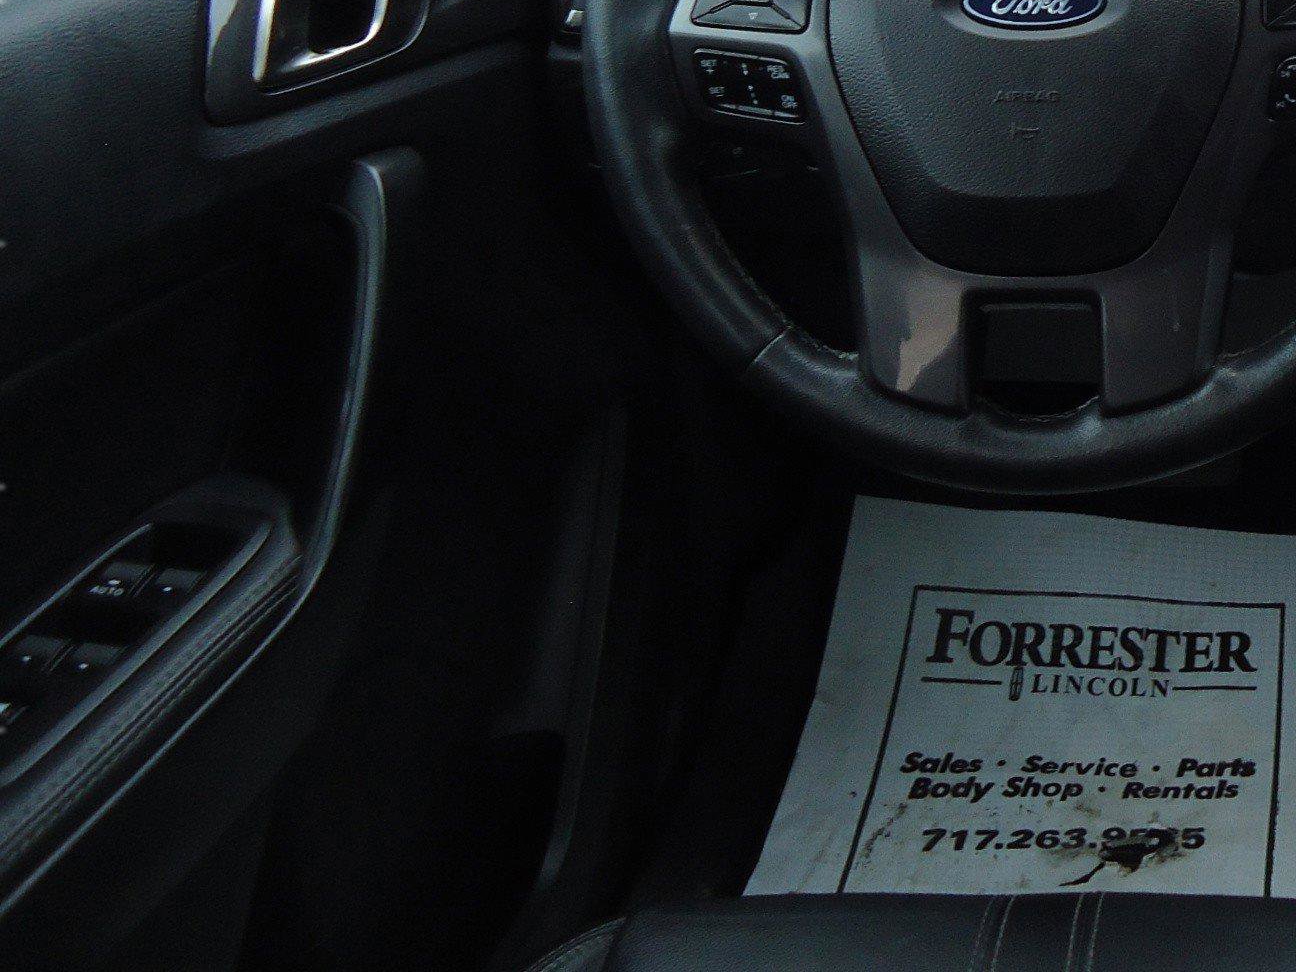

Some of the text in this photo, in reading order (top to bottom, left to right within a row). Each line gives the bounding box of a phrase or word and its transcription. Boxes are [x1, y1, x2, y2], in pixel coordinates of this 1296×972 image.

[924, 607, 1258, 674] FORRESTER
[1032, 673, 1172, 698] LINCOLN
[899, 752, 1257, 779] Sales Service Parts
[907, 776, 1240, 803] Body Shop Rentals
